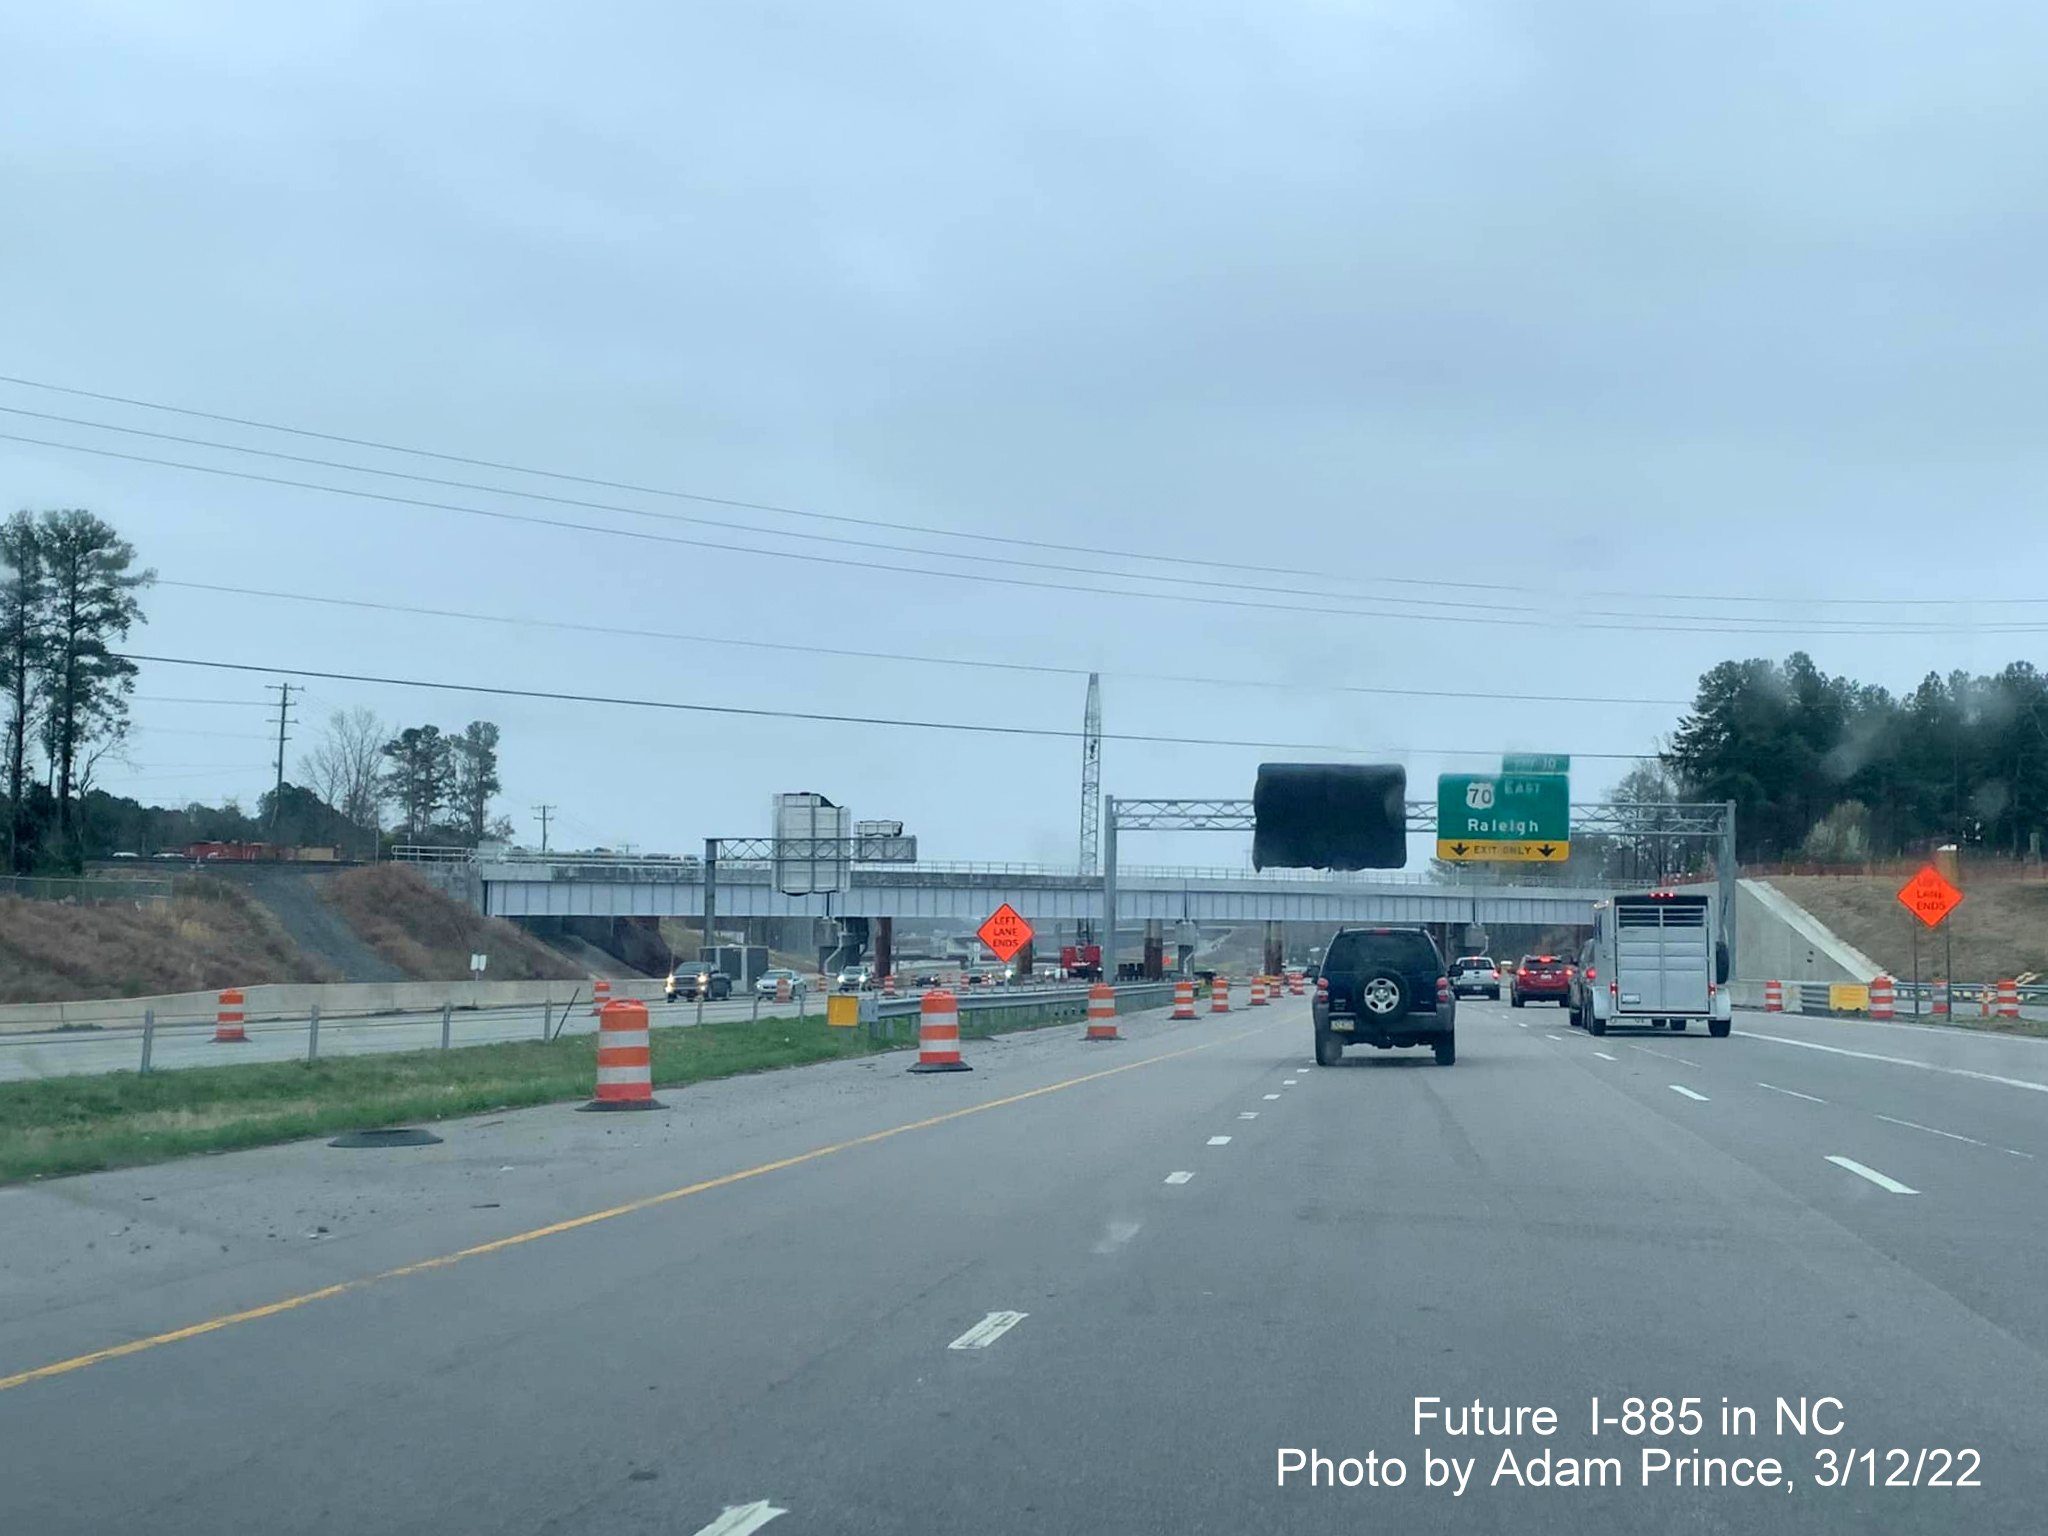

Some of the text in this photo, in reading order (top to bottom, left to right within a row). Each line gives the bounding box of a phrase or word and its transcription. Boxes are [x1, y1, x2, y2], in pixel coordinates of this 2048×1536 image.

[1468, 780, 1540, 805] 70 EAST
[1468, 819, 1538, 835] Raleigh
[1473, 845, 1532, 855] EXIT ONLY
[994, 916, 1016, 925] LEFT
[993, 927, 1018, 937] LANE
[992, 938, 1019, 948] ENDS
